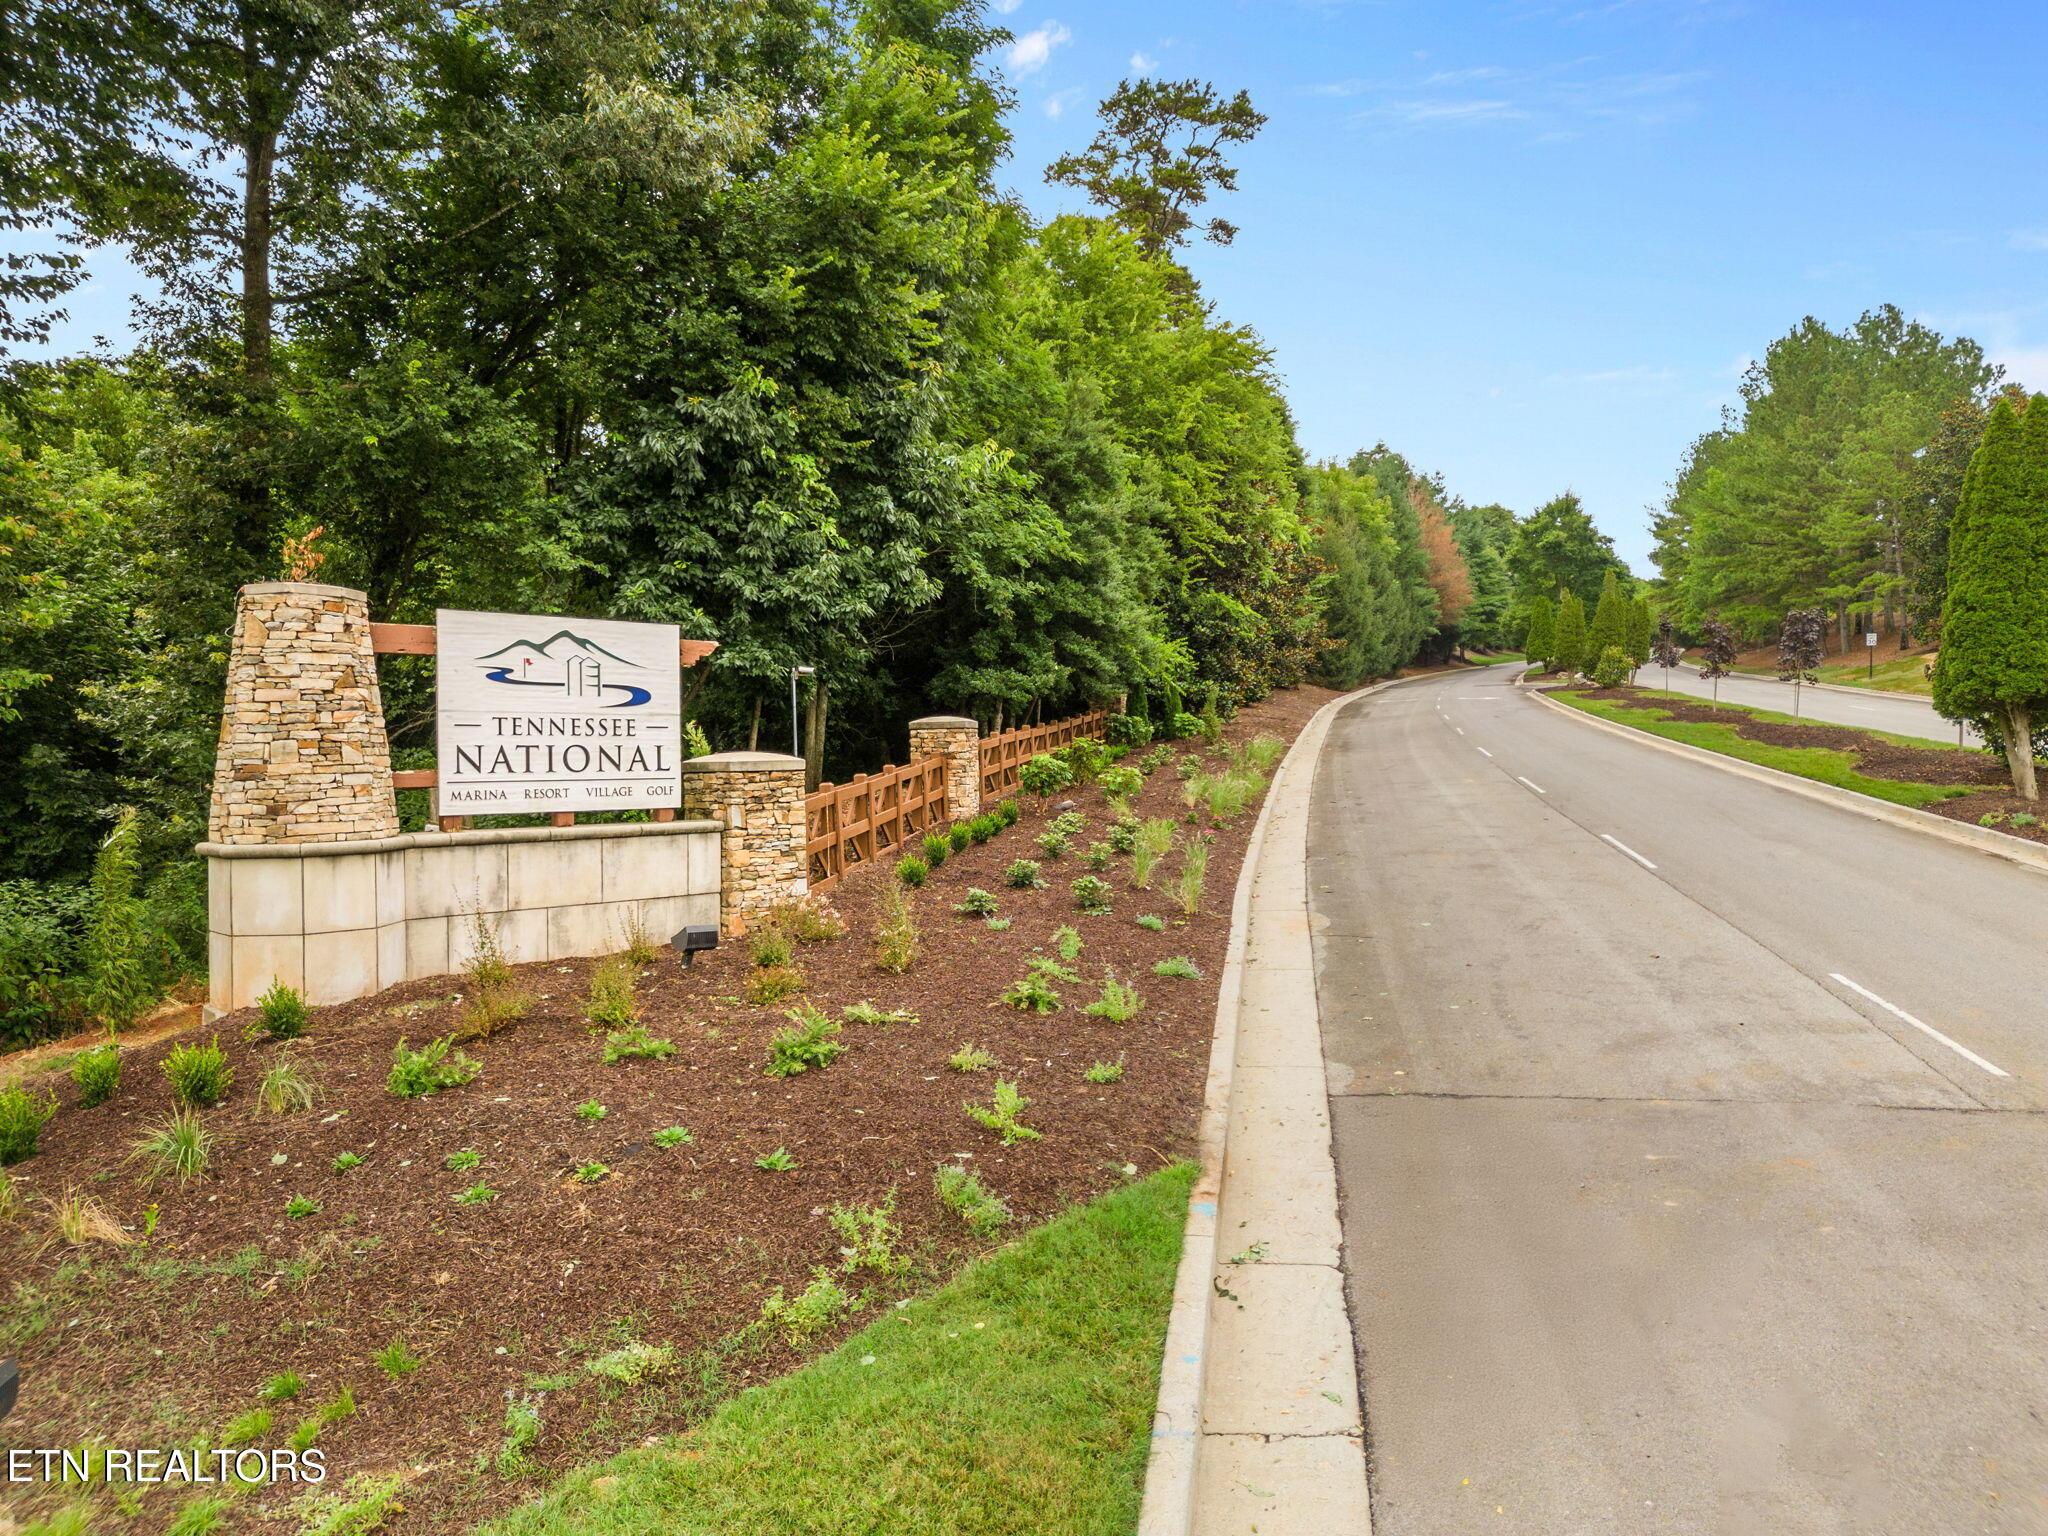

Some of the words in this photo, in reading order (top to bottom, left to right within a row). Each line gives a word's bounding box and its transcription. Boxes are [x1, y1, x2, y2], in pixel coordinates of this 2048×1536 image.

[492, 716, 637, 737] TENNESSEE
[453, 744, 671, 775] NATIONAL
[451, 789, 508, 801] MARINA
[524, 788, 570, 799] RESORT
[585, 786, 633, 798] VILLAGE
[646, 785, 675, 796] GOLF
